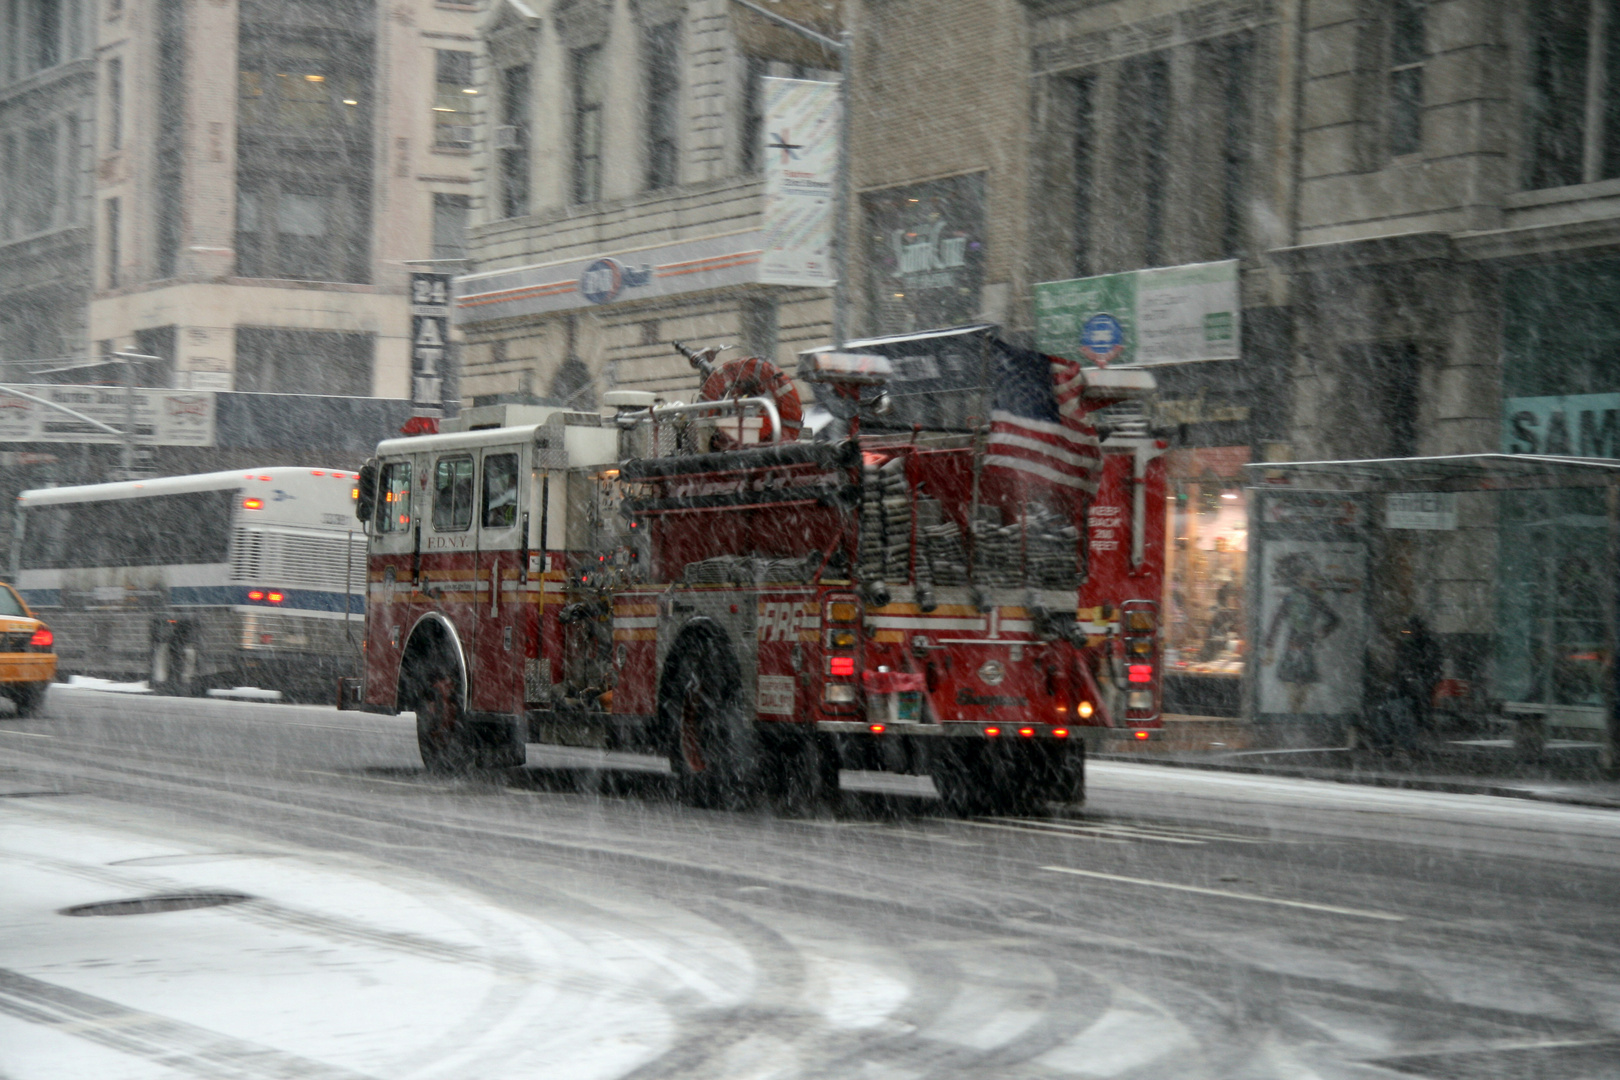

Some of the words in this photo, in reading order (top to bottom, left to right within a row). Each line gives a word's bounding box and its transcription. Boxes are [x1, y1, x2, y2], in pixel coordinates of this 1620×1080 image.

[413, 280, 446, 302] 24
[413, 318, 445, 404] ATM
[1088, 506, 1121, 516] KEEP
[1087, 517, 1122, 527] BACK
[1089, 540, 1119, 551] FEET
[761, 601, 805, 641] FIRE
